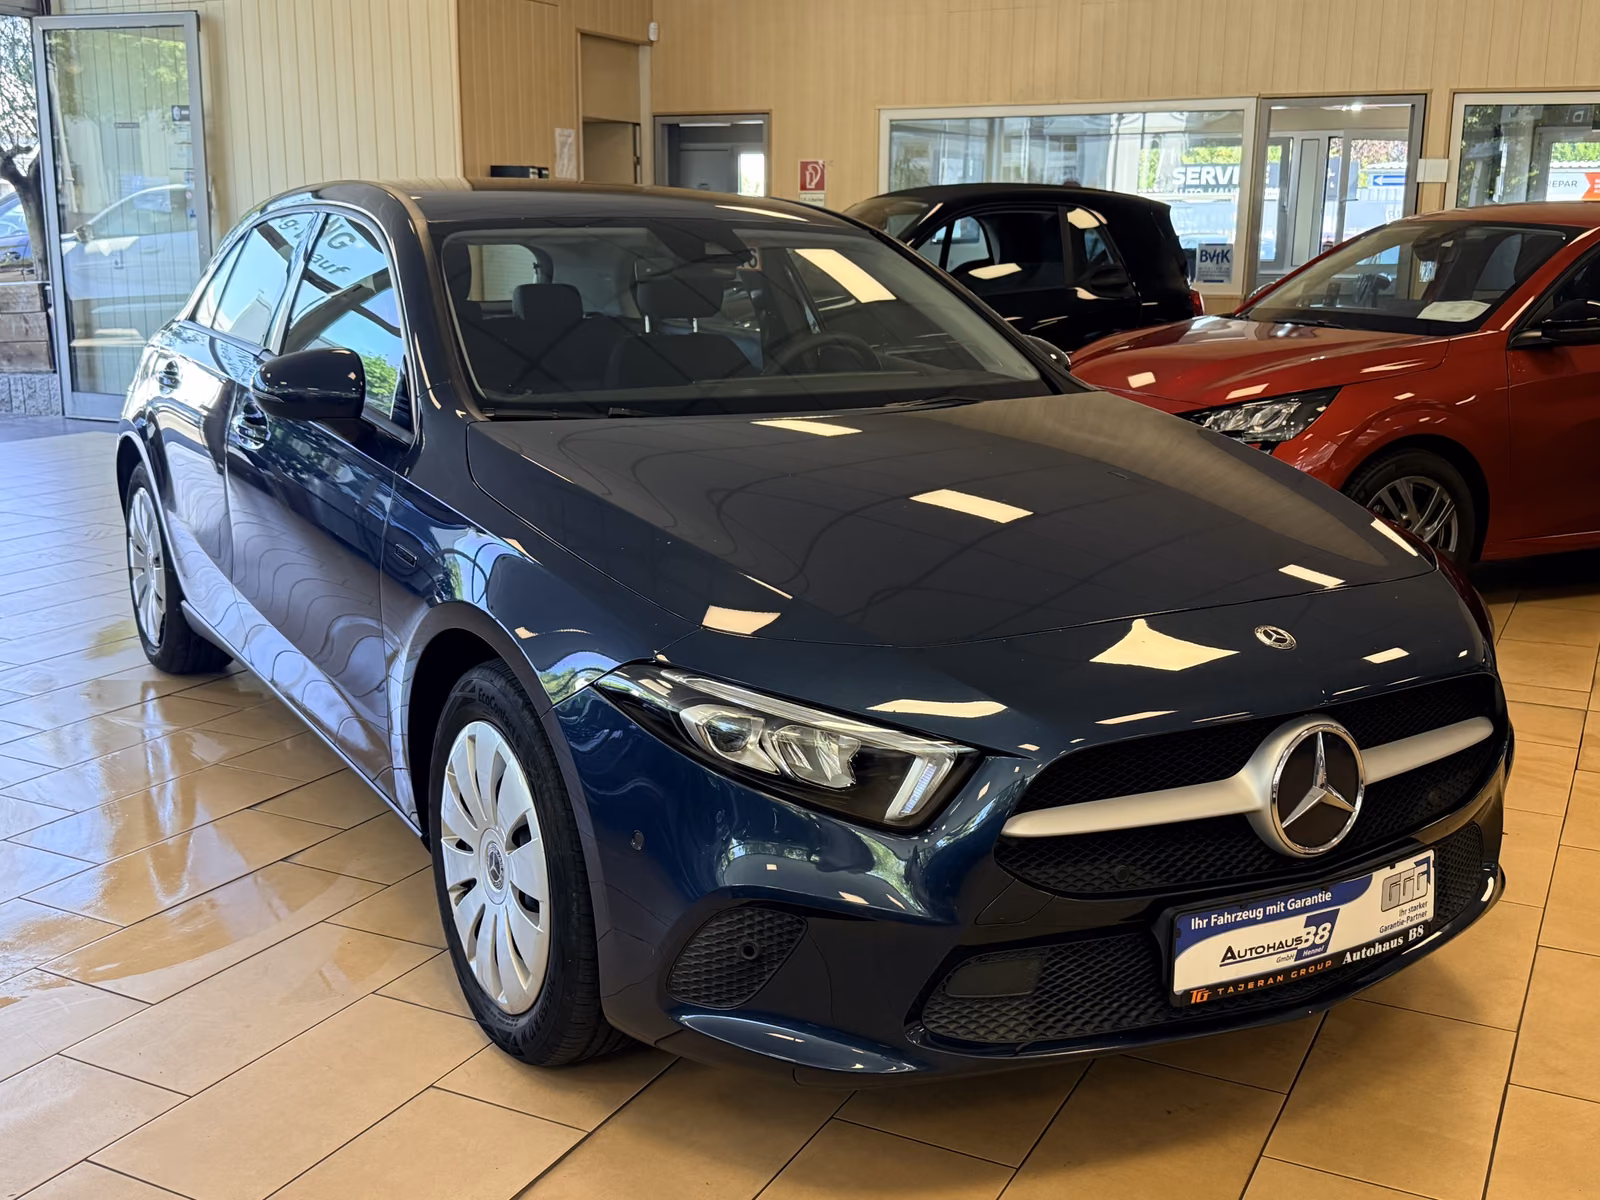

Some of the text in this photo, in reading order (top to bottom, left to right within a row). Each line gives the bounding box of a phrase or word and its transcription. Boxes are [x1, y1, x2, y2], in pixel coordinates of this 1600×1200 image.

[1191, 891, 1332, 930] Ihr Fahrzeug mit Garantie
[1407, 901, 1428, 914] starker
[1302, 922, 1332, 949] B8
[1379, 910, 1428, 934] Garantie-Partner
[1342, 924, 1424, 965] Autohaus B8
[1275, 954, 1295, 964] GmbH
[1217, 974, 1284, 995] TAJERAN
[1290, 960, 1332, 979] GROUP
